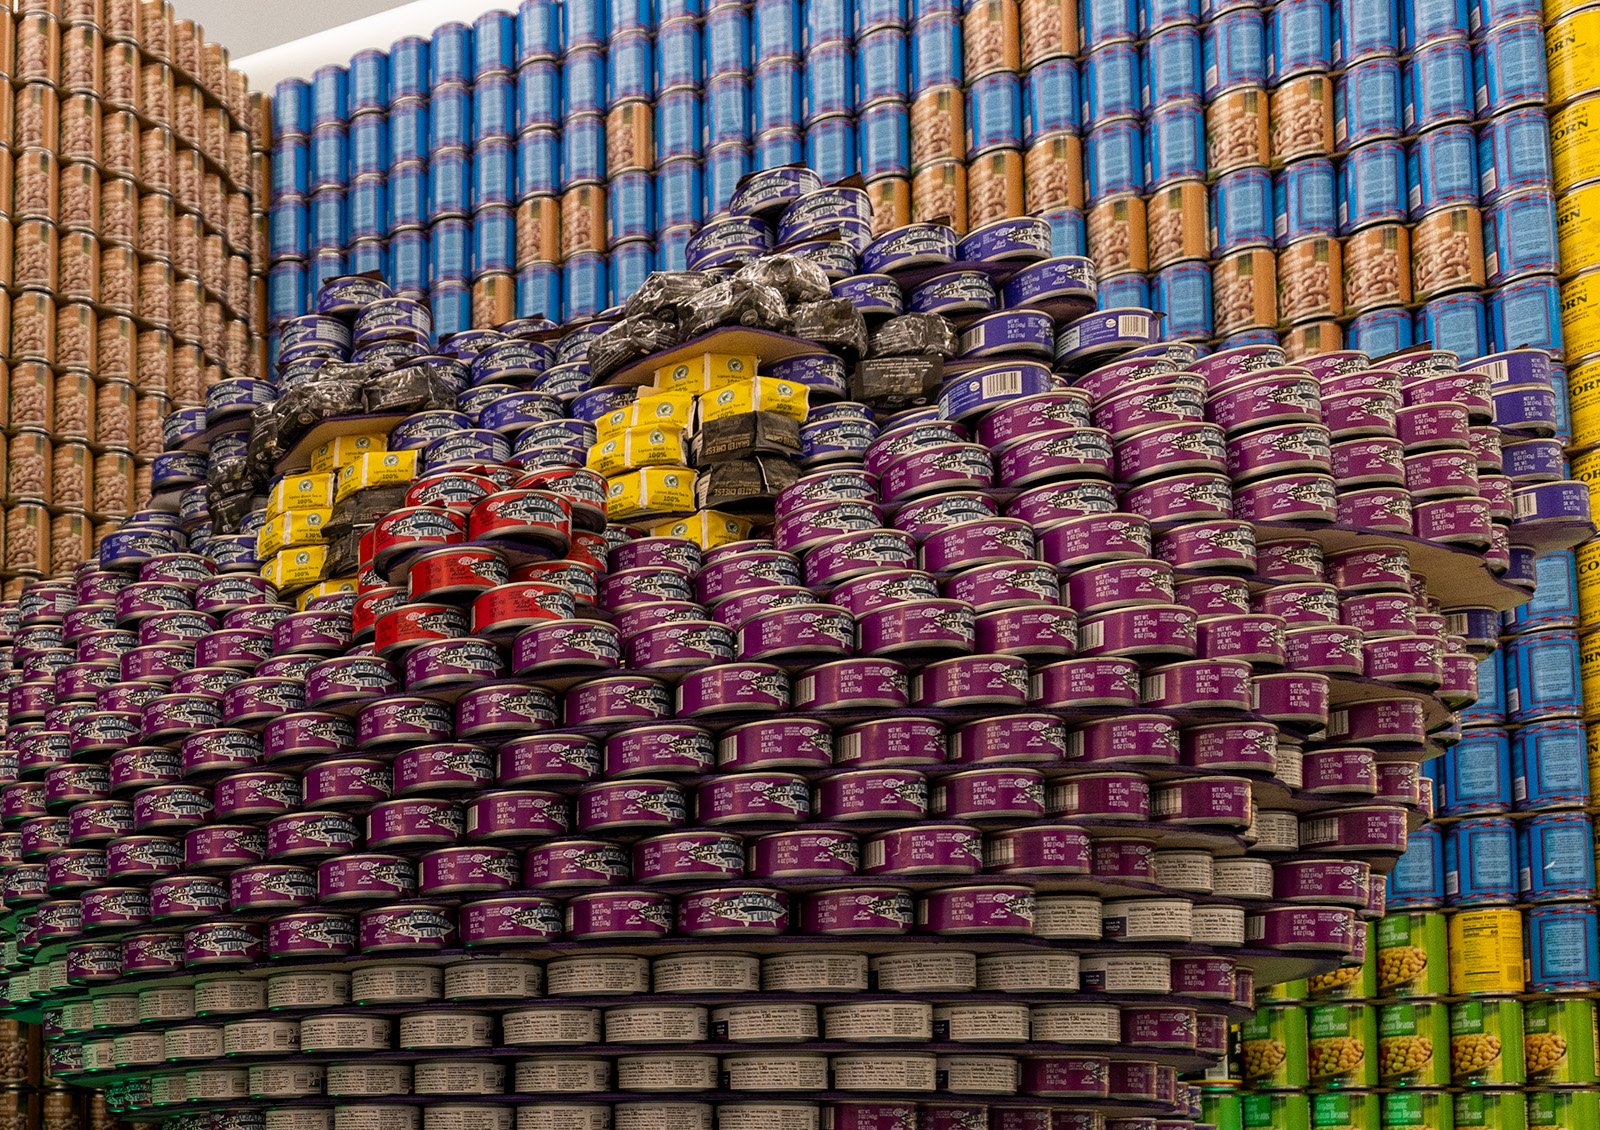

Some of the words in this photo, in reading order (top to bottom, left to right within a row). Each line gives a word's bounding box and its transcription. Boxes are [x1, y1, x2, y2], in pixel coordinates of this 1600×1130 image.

[648, 451, 667, 459] 100%
[838, 489, 863, 499] TUNA
[531, 512, 556, 522] TUNA
[952, 513, 980, 523] TUNA
[880, 551, 904, 561] TUNA
[226, 592, 247, 600] TUNA
[471, 661, 495, 670] TUNA
[104, 731, 126, 739] TUNA
[199, 897, 221, 906] TUNA
[418, 928, 443, 937] TUNA
[219, 942, 244, 951] TUNA
[1329, 1021, 1347, 1031] Beans
[1397, 1020, 1414, 1029] Beans
